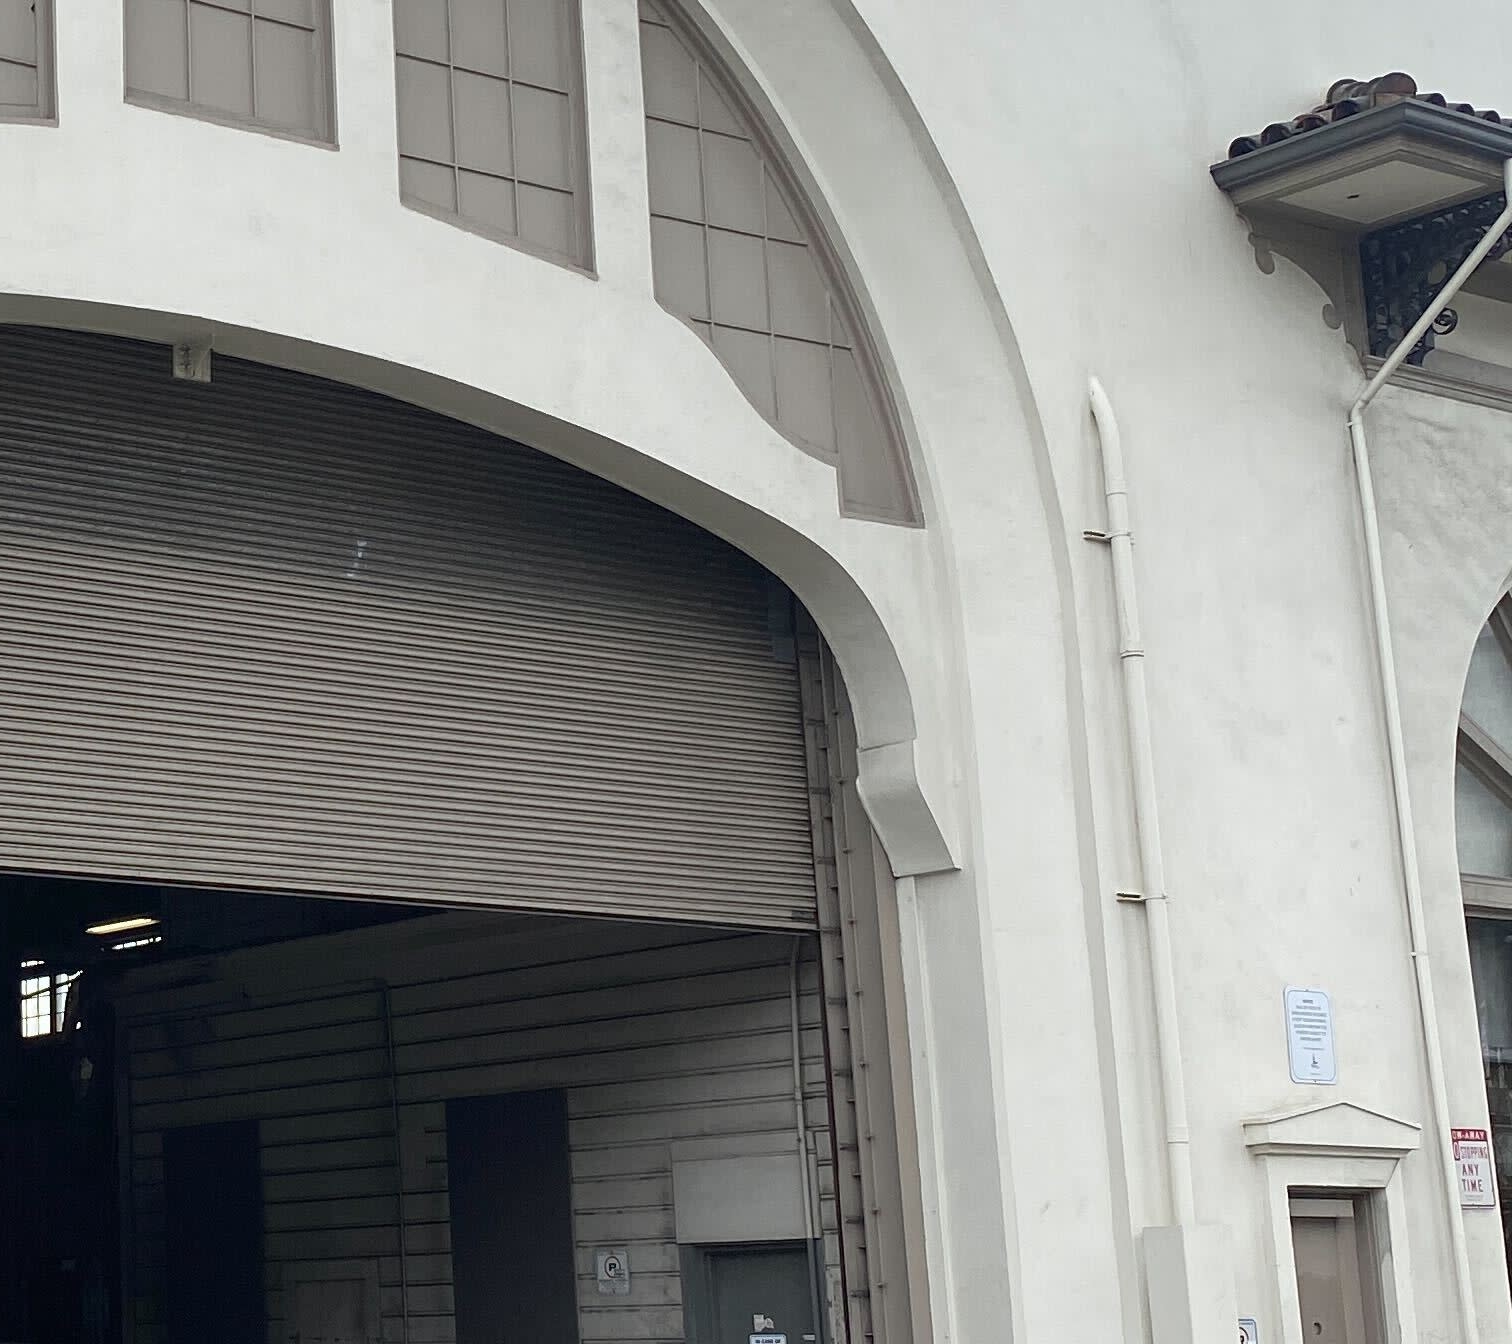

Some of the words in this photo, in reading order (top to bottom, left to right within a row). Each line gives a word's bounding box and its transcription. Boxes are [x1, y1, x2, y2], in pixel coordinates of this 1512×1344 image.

[1451, 1129, 1485, 1140] OW-AWAY
[1462, 1163, 1479, 1177] ANY
[1462, 1178, 1484, 1193] TIME
